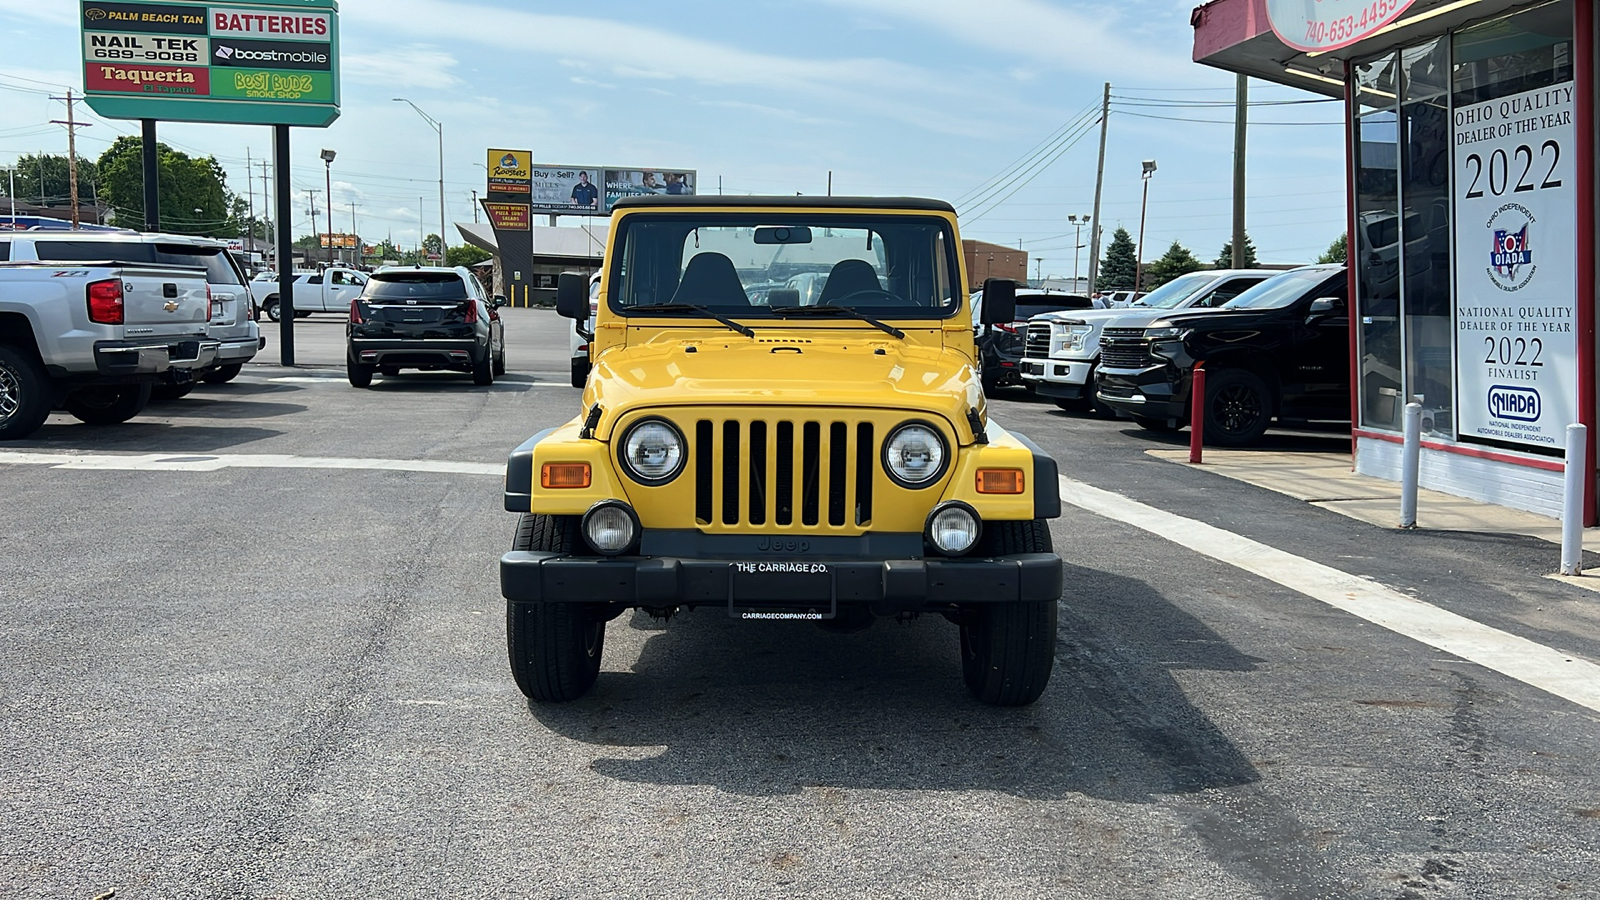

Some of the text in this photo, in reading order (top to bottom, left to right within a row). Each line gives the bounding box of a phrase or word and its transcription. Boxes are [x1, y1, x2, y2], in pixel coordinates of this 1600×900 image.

[108, 11, 204, 24] PALM BEACH TAN
[215, 13, 327, 35] BATTERIES
[1304, 0, 1397, 43] 740-653-4455
[91, 35, 198, 51] NAIL TEK
[94, 48, 198, 62] 689-9088
[235, 48, 327, 63] boostmobile
[272, 74, 313, 93] BUDZ
[246, 90, 301, 99] SMOKE SHOP
[1455, 105, 1493, 126] OHIO
[1500, 86, 1573, 118] QUALITY
[1457, 110, 1571, 145] DEALER OF THE YEAR
[492, 166, 527, 177] Roosters
[534, 170, 549, 178] Buy
[557, 171, 575, 179] Sell?
[1465, 139, 1562, 199] 2022
[606, 181, 632, 189] WHERE
[1486, 203, 1536, 229] OHIO INDEPENDENT
[1495, 252, 1525, 265] OIADA
[1459, 307, 1572, 319] NATIONAL QUALITY
[1460, 321, 1570, 332] DEALER OF THE YEAR
[1484, 336, 1543, 366] 2022
[1488, 368, 1538, 380] FINALIST
[1492, 392, 1536, 415] NIADA
[1511, 423, 1541, 432] INDEPENDENT
[1477, 428, 1555, 443] AUTOMOBILE DEALERS ASSOCIATION
[758, 536, 810, 552] Jeep
[737, 563, 828, 573] THE CARRIAGE CO.
[742, 612, 822, 620] CARRIAGECOMPANY.COM
